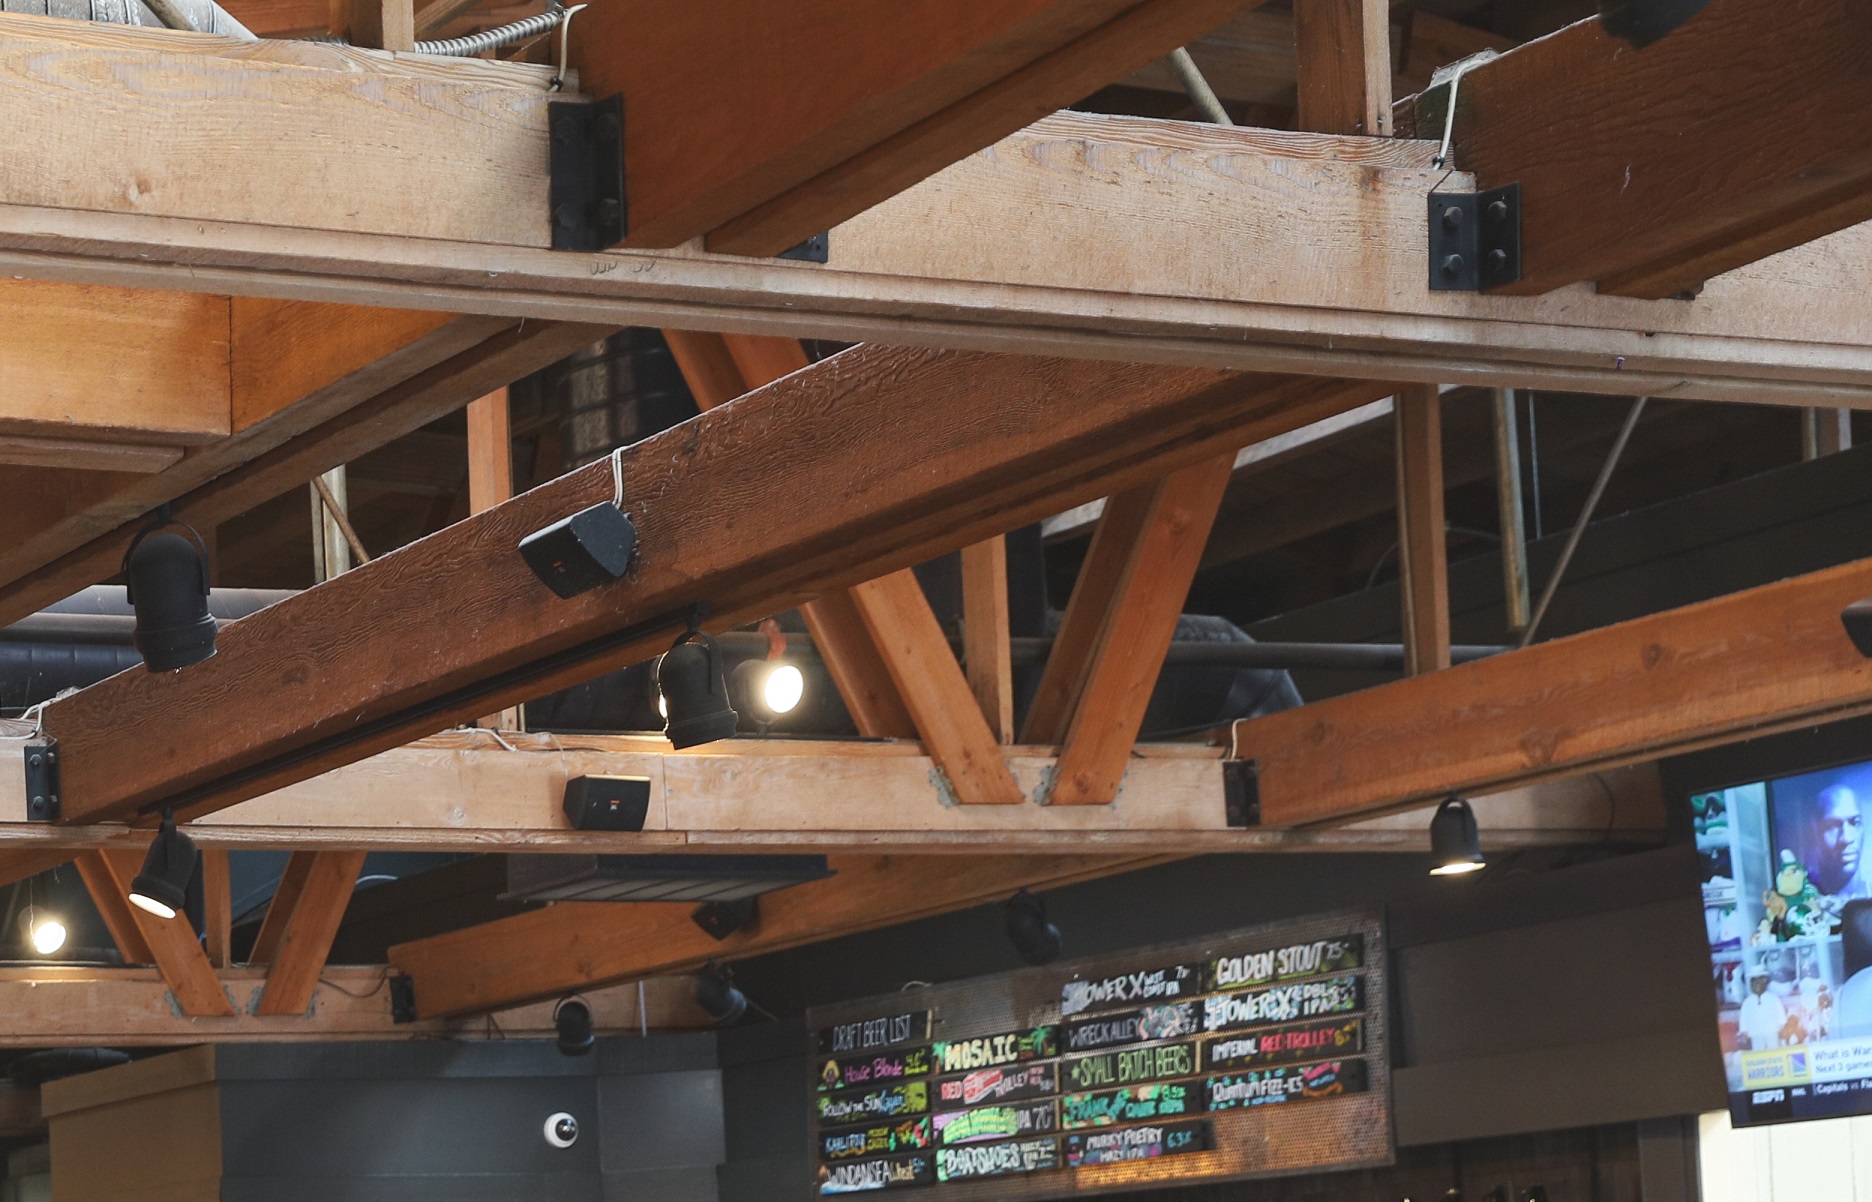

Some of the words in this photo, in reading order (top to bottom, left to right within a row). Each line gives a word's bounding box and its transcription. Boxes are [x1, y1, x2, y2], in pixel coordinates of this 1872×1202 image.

[1217, 950, 1275, 985] GOLDEN
[1278, 941, 1327, 974] STOUT
[1128, 971, 1146, 999] X
[832, 1023, 863, 1051] DRAFT
[863, 1017, 888, 1047] BEER
[889, 1014, 911, 1042] LIST
[1212, 1037, 1257, 1062] IMPERIAL
[1260, 1033, 1283, 1053] RED
[1286, 1027, 1336, 1049] TROLLEY
[944, 1033, 1018, 1072] MOSAIC
[1080, 1055, 1115, 1087] SMALL
[1118, 1047, 1155, 1082] BATCH
[1155, 1044, 1192, 1077] BEERS
[1814, 1048, 1839, 1060] What
[1852, 1045, 1872, 1056] War
[941, 1081, 964, 1100] RED
[1816, 1082, 1849, 1095] Capitals
[1086, 1133, 1123, 1150] MURKY
[1123, 1127, 1164, 1148] POETRY
[827, 1160, 894, 1186] WINDANSEA
[945, 1143, 1021, 1175] BOATSHOES
